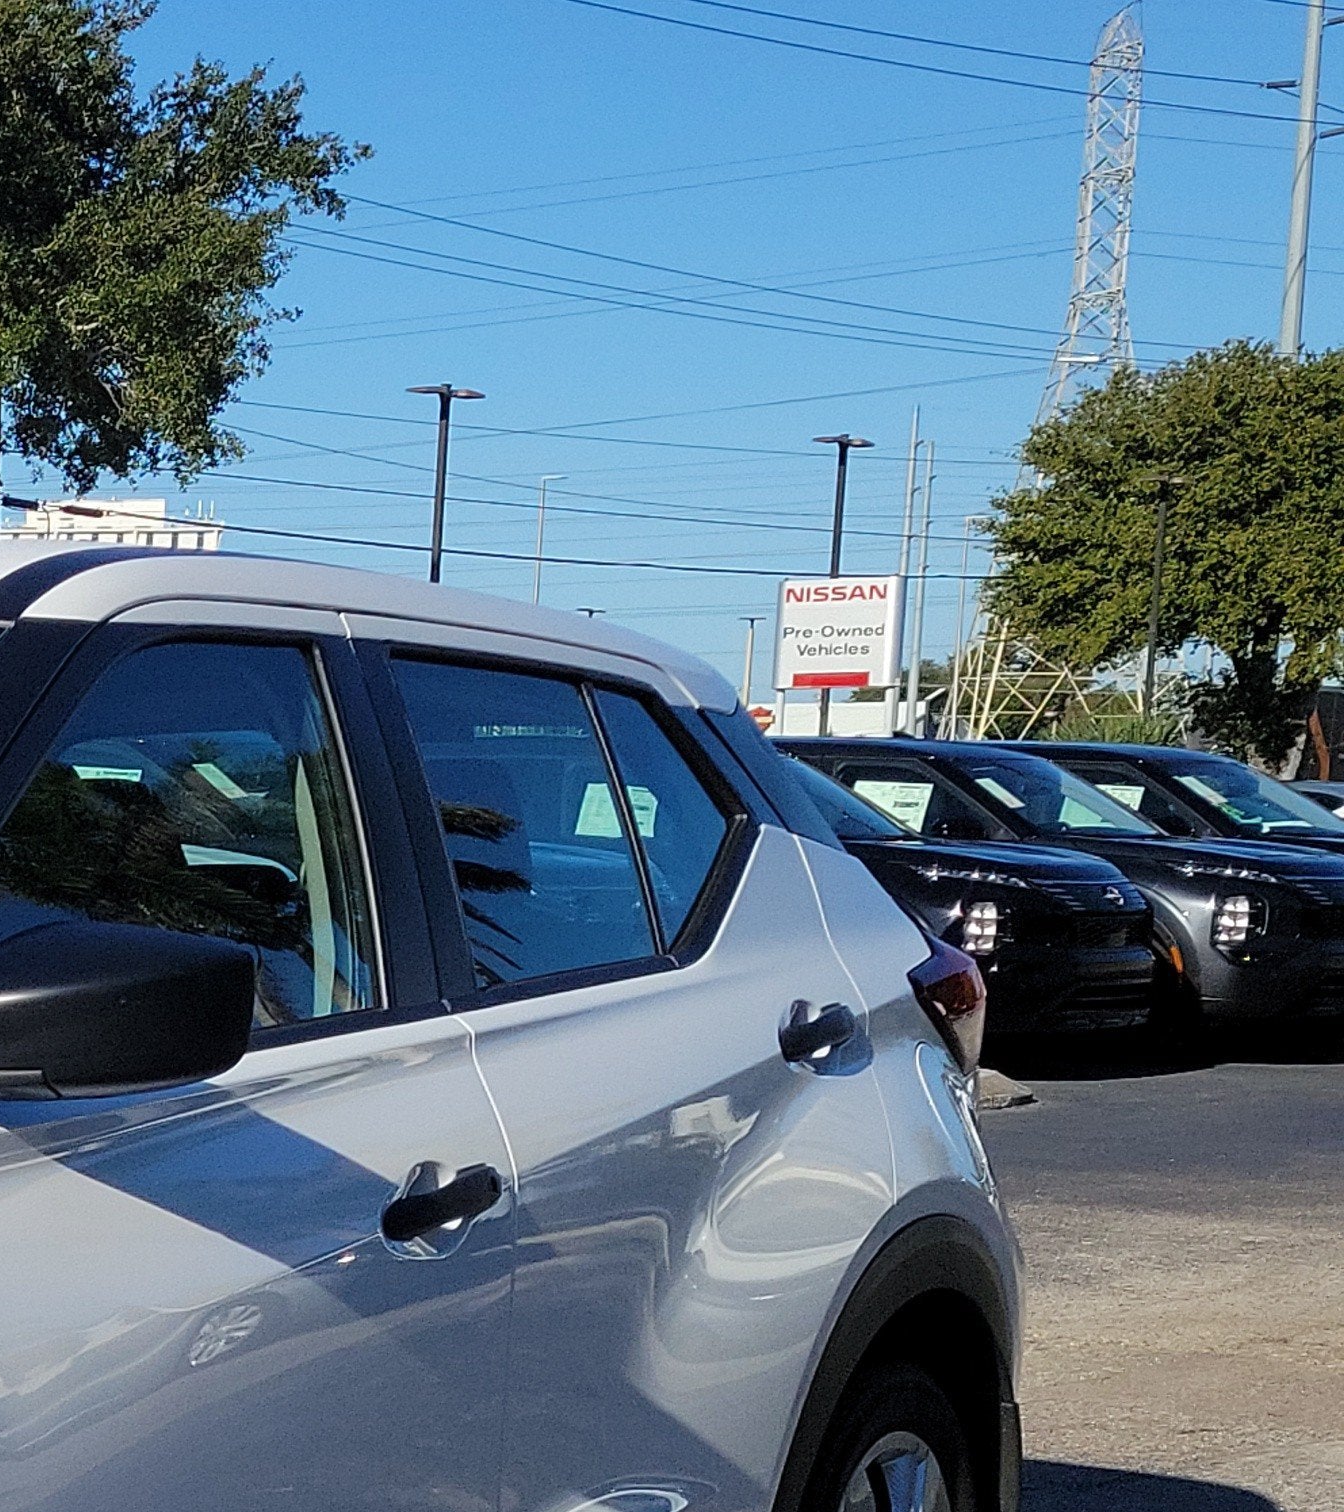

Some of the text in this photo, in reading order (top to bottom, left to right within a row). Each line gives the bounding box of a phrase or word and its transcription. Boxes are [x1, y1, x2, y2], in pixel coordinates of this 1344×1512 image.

[785, 583, 888, 603] NISSAN
[783, 623, 885, 639] Pre-Owned
[796, 642, 870, 657] Vehicles
